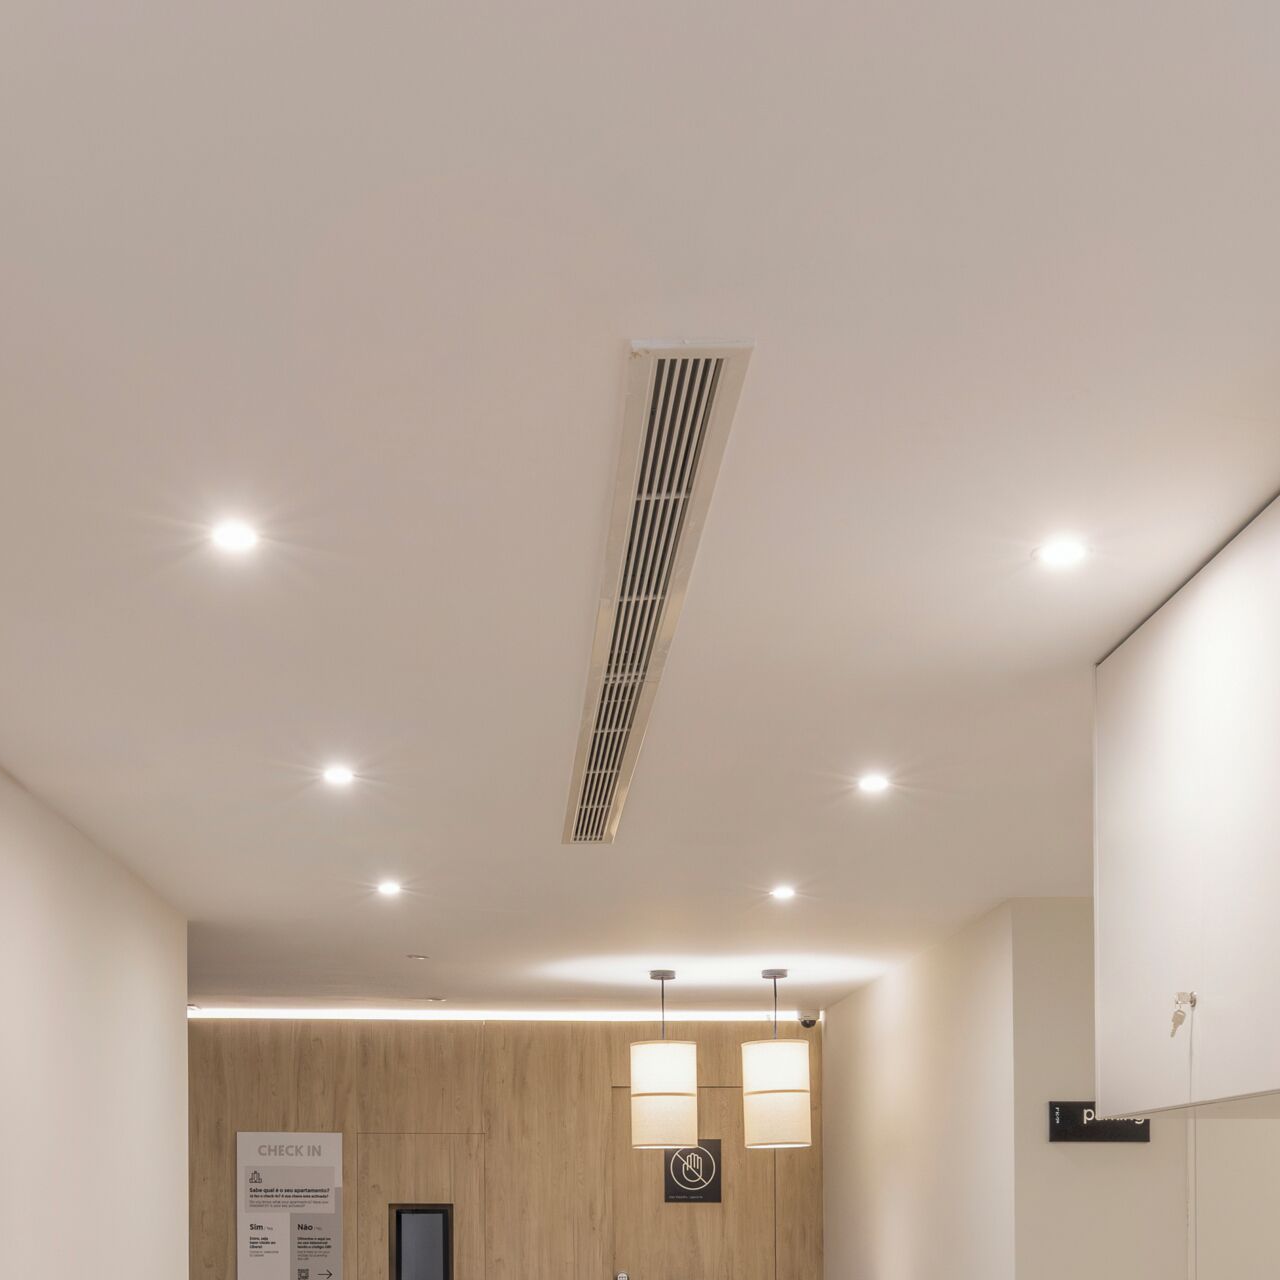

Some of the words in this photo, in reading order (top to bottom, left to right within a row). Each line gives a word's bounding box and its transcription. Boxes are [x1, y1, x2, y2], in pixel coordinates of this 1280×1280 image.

[258, 1144, 304, 1157] CHECK
[307, 1144, 322, 1157] IN
[249, 1223, 264, 1231] Sim
[297, 1223, 313, 1231] Não
